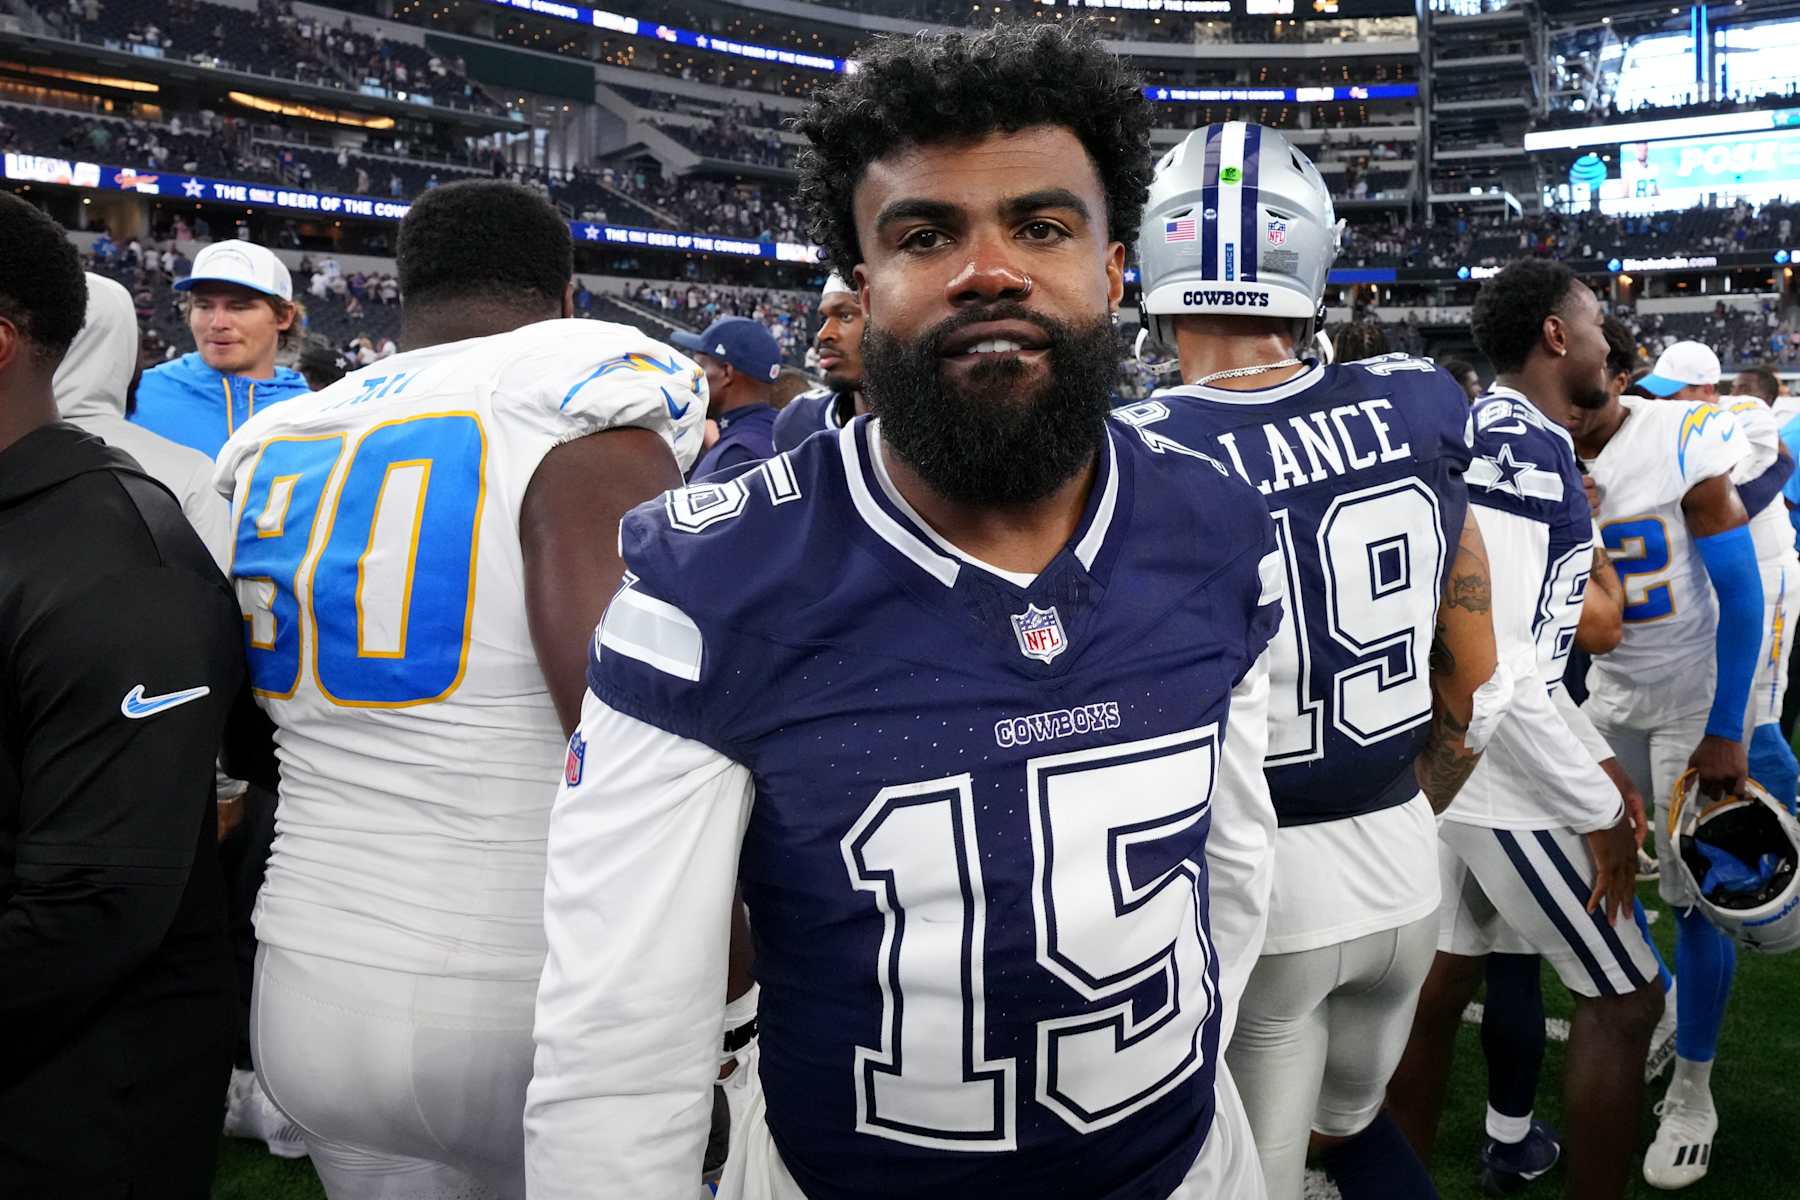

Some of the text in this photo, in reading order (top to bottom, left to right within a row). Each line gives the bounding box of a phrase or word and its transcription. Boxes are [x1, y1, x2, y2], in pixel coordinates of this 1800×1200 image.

[213, 183, 247, 201] THE
[277, 191, 318, 210] BEER
[320, 197, 341, 212] OF
[343, 199, 373, 215] THE
[374, 202, 412, 218] COW
[1183, 290, 1270, 308] COWBOYS
[1217, 398, 1412, 495] LANCE
[230, 410, 488, 709] 90
[1025, 627, 1060, 652] NFL
[1262, 475, 1448, 769] 19
[994, 701, 1121, 748] COWBOYS
[839, 722, 1219, 1152] 15
